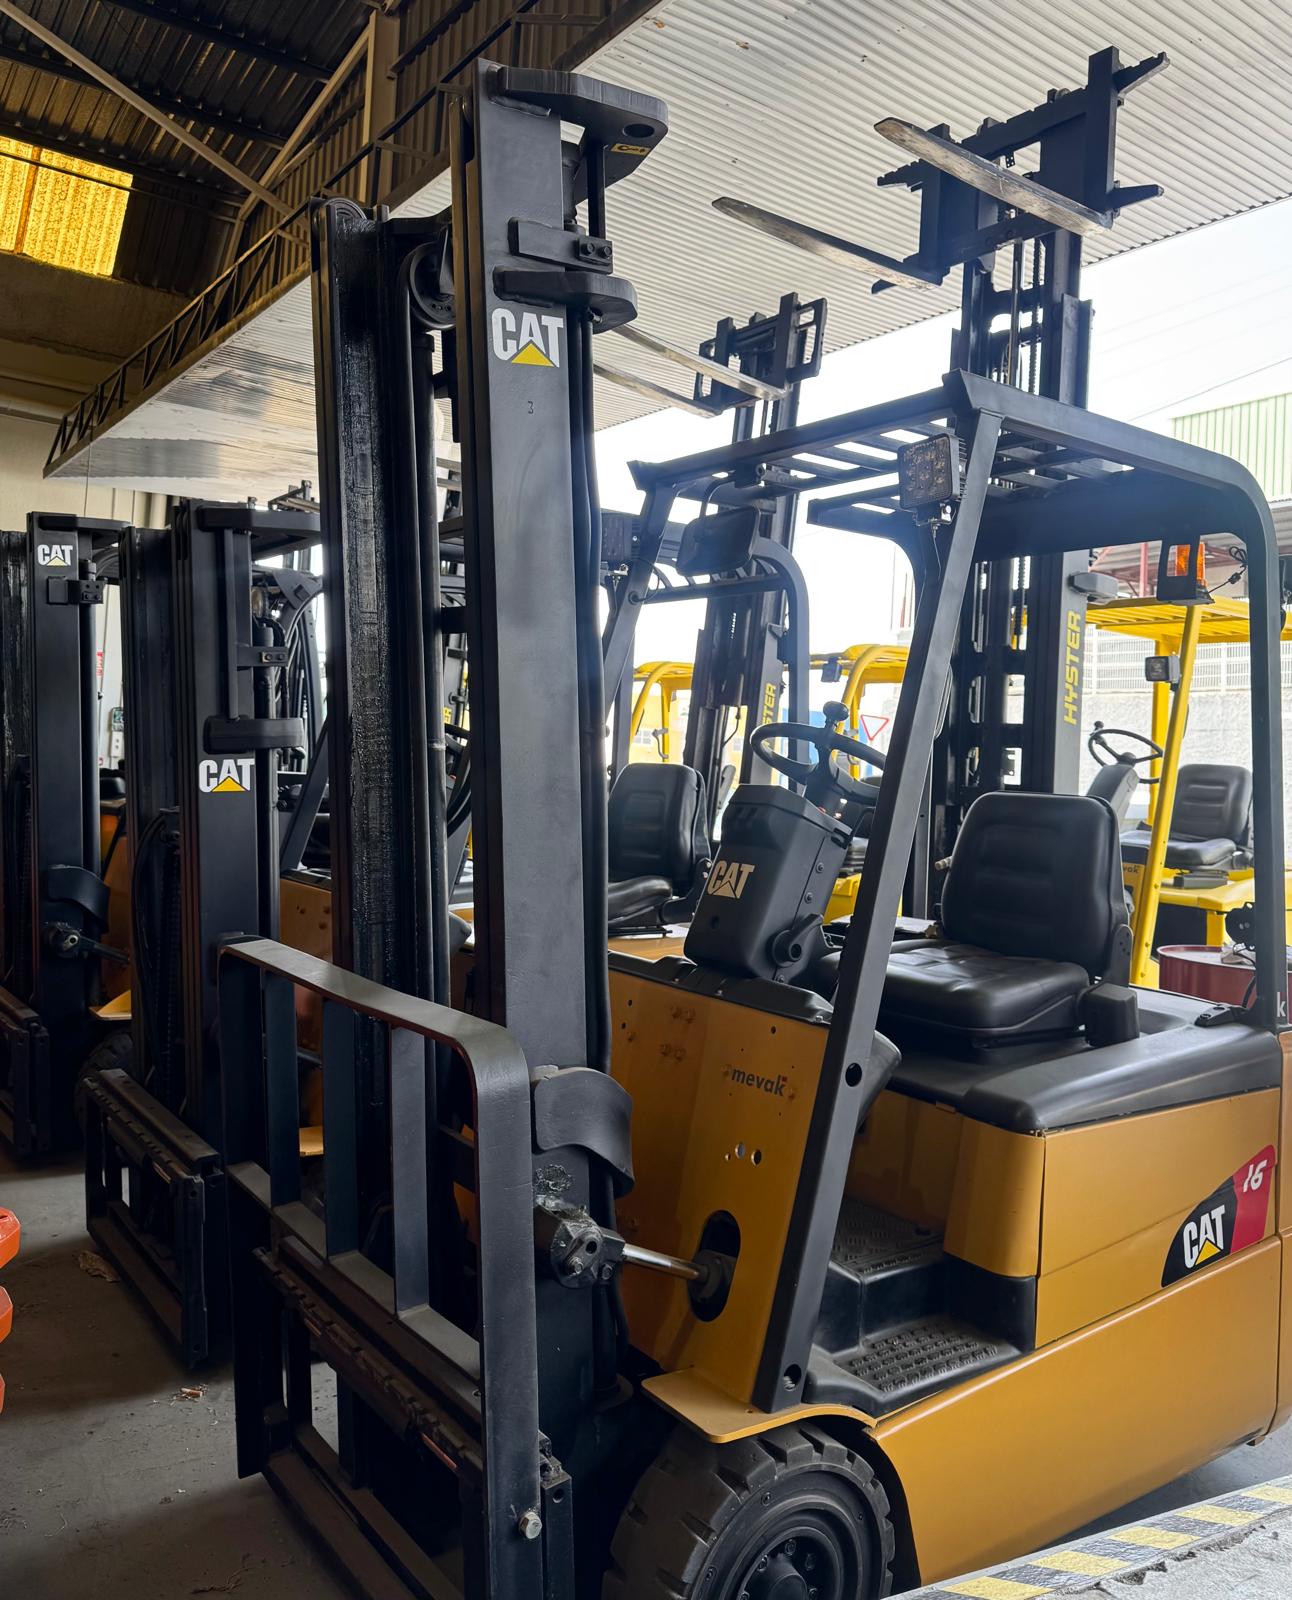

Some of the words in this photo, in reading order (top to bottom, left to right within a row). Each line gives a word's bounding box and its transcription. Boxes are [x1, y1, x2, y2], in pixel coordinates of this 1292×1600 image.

[491, 308, 564, 368] CAT
[37, 544, 73, 566] CAT
[1063, 610, 1081, 726] HYSTER
[199, 759, 255, 792] CAT
[707, 860, 755, 899] CAT
[732, 1069, 785, 1096] mevak
[1243, 1160, 1267, 1193] 16
[1183, 1204, 1226, 1269] CAT
